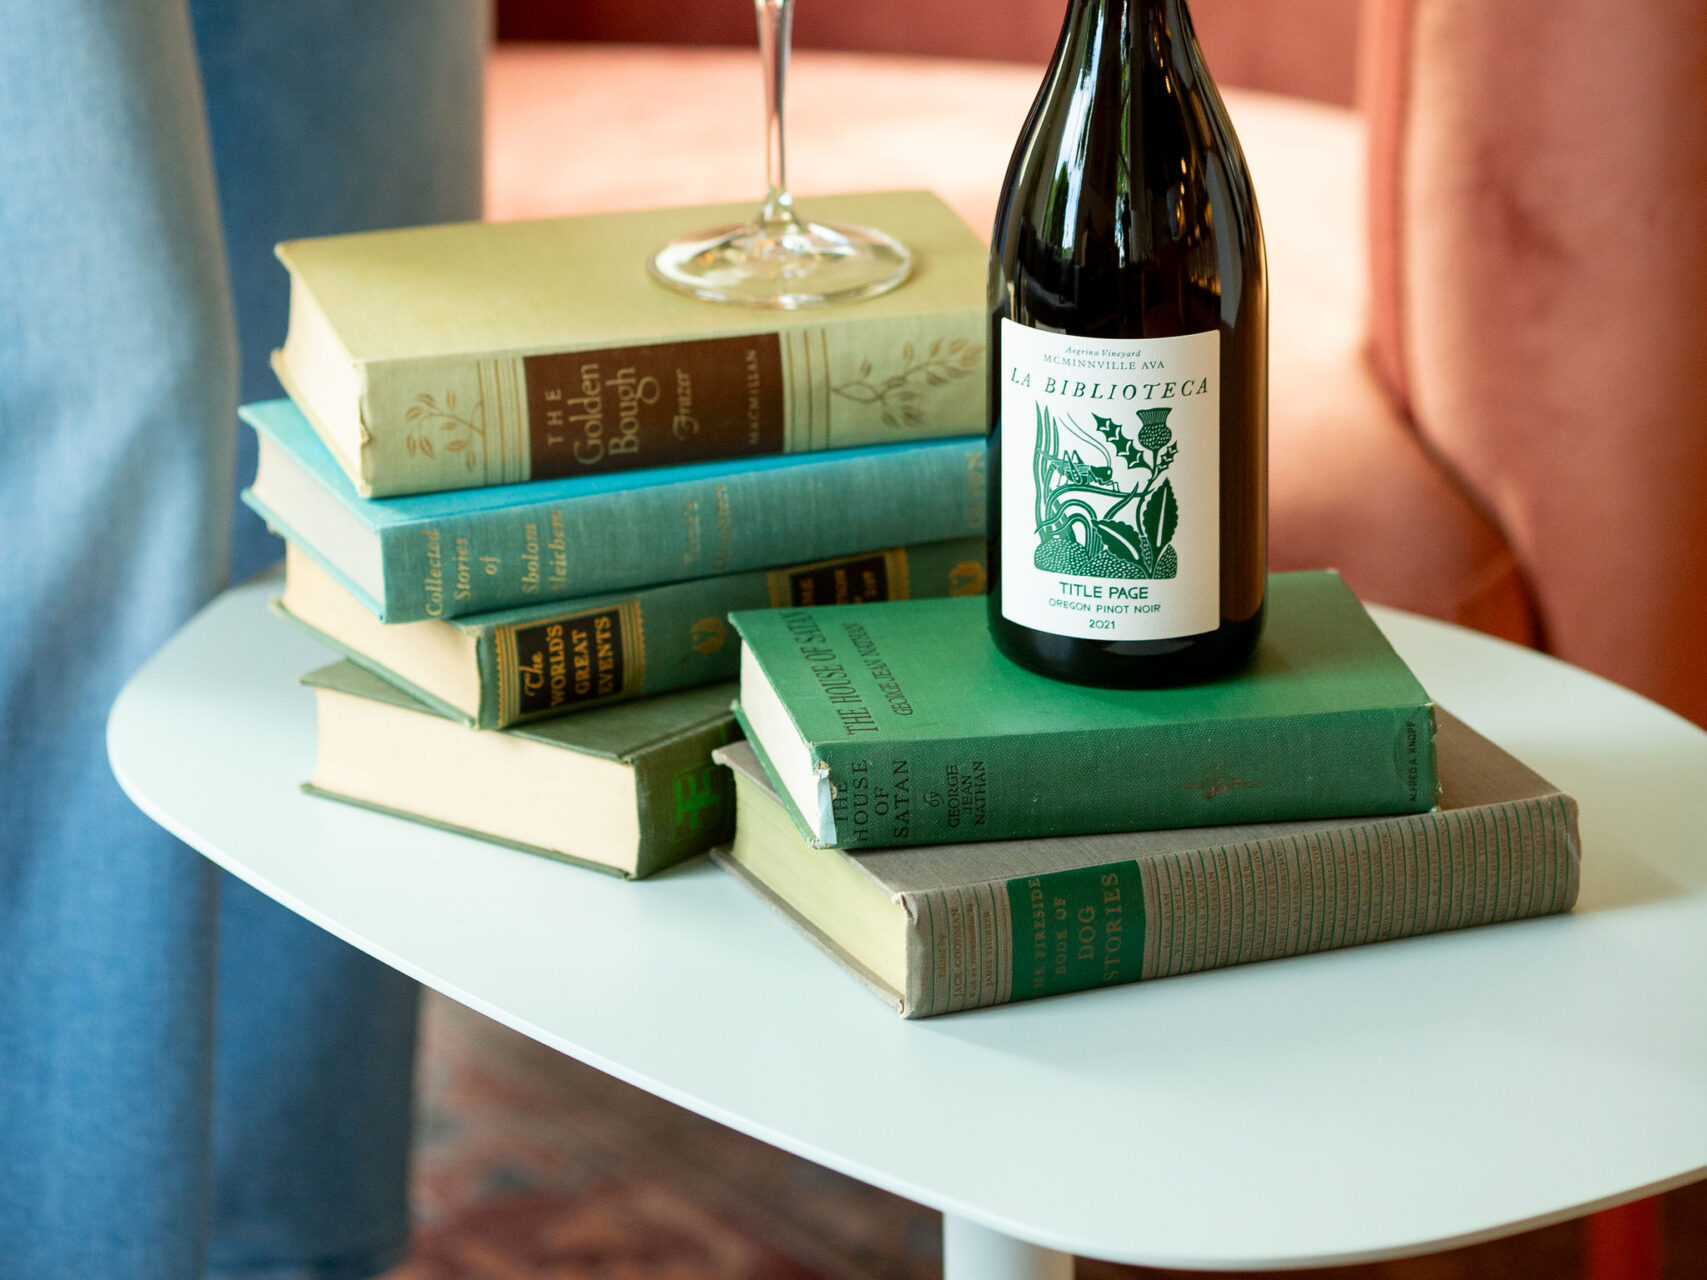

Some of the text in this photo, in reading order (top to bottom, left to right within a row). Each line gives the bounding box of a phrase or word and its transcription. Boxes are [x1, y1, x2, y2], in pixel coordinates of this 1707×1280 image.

[1043, 354, 1165, 370] MCMINNVILLE AVA
[1101, 349, 1142, 358] Vineyard
[746, 349, 760, 445] MACMILLAN
[1011, 367, 1208, 400] LA BIBLIOTECA
[545, 388, 564, 446] THE
[567, 363, 605, 465] Golden
[605, 367, 661, 455] Bough
[420, 528, 443, 616] Collected
[452, 537, 471, 601] Stories
[479, 556, 501, 576] of
[521, 523, 539, 595] Sholom
[1048, 598, 1161, 614] OREGON PINOT NOIR
[1059, 581, 1149, 600] TITLE PAGE
[1089, 619, 1115, 629] 2021
[520, 651, 545, 697] The
[571, 629, 591, 695] GREAT
[800, 646, 836, 662] OF
[811, 664, 863, 704] HOUSE
[878, 683, 914, 716] GEORGE
[837, 707, 879, 735] THE
[832, 781, 849, 822] THE
[852, 759, 869, 842] HOUSE
[875, 786, 890, 816] OF
[892, 759, 910, 839] SATAN
[923, 791, 944, 808] by
[946, 764, 961, 829] GEORGE
[962, 774, 973, 815] JEAN
[972, 760, 986, 826] NATHAN
[1217, 853, 1227, 880] DAVIS
[1243, 865, 1252, 892] DYER
[1253, 850, 1263, 902] EDMONDS
[1311, 845, 1321, 890] KANTOR
[1324, 847, 1333, 891] KIPLING
[1174, 883, 1182, 910] BELL
[1185, 871, 1194, 914] CORWIN
[1028, 877, 1045, 959] FIRESIDE
[1054, 897, 1067, 975] BOOK OF
[1077, 906, 1096, 959] DOG
[1102, 872, 1122, 982] STORIES
[1163, 893, 1171, 949] JACK ALAN
[1243, 912, 1252, 951] WALTER
[951, 907, 964, 997] JACK GOODMAN
[983, 912, 993, 986] JAMES THURBER
